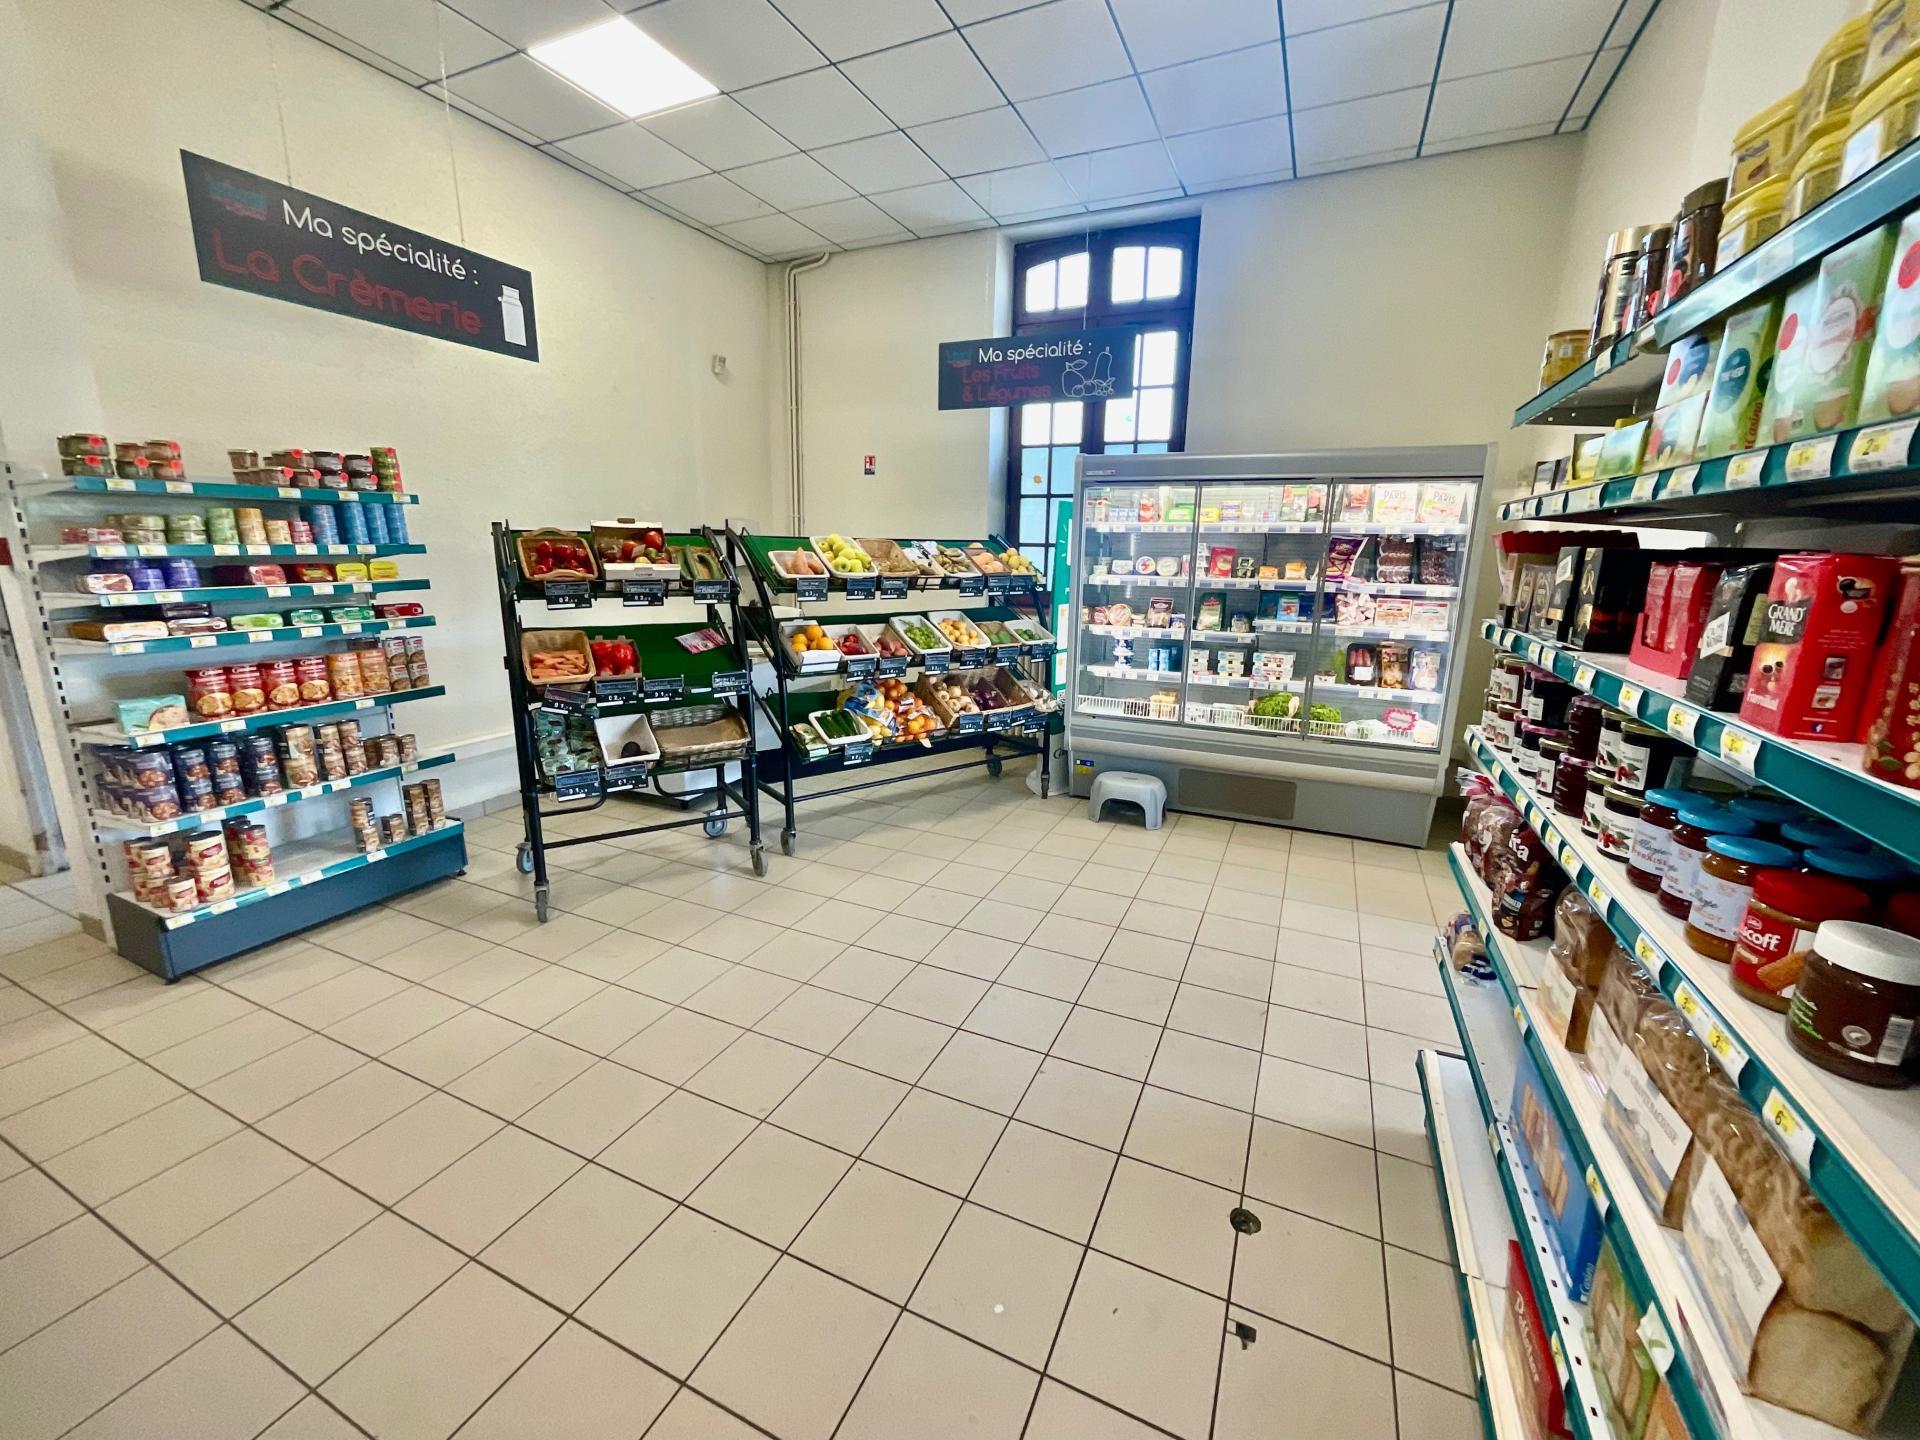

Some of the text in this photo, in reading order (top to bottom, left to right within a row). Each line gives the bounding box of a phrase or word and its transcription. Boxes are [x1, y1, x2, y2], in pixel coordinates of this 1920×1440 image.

[282, 199, 333, 240] Ma
[341, 224, 467, 281] spécialité
[211, 228, 482, 335] La Crèmerie
[978, 346, 1003, 364] Ma
[1006, 339, 1083, 366] spécialité
[961, 362, 1041, 384] Les Fruits
[961, 384, 1051, 405] & Légumes
